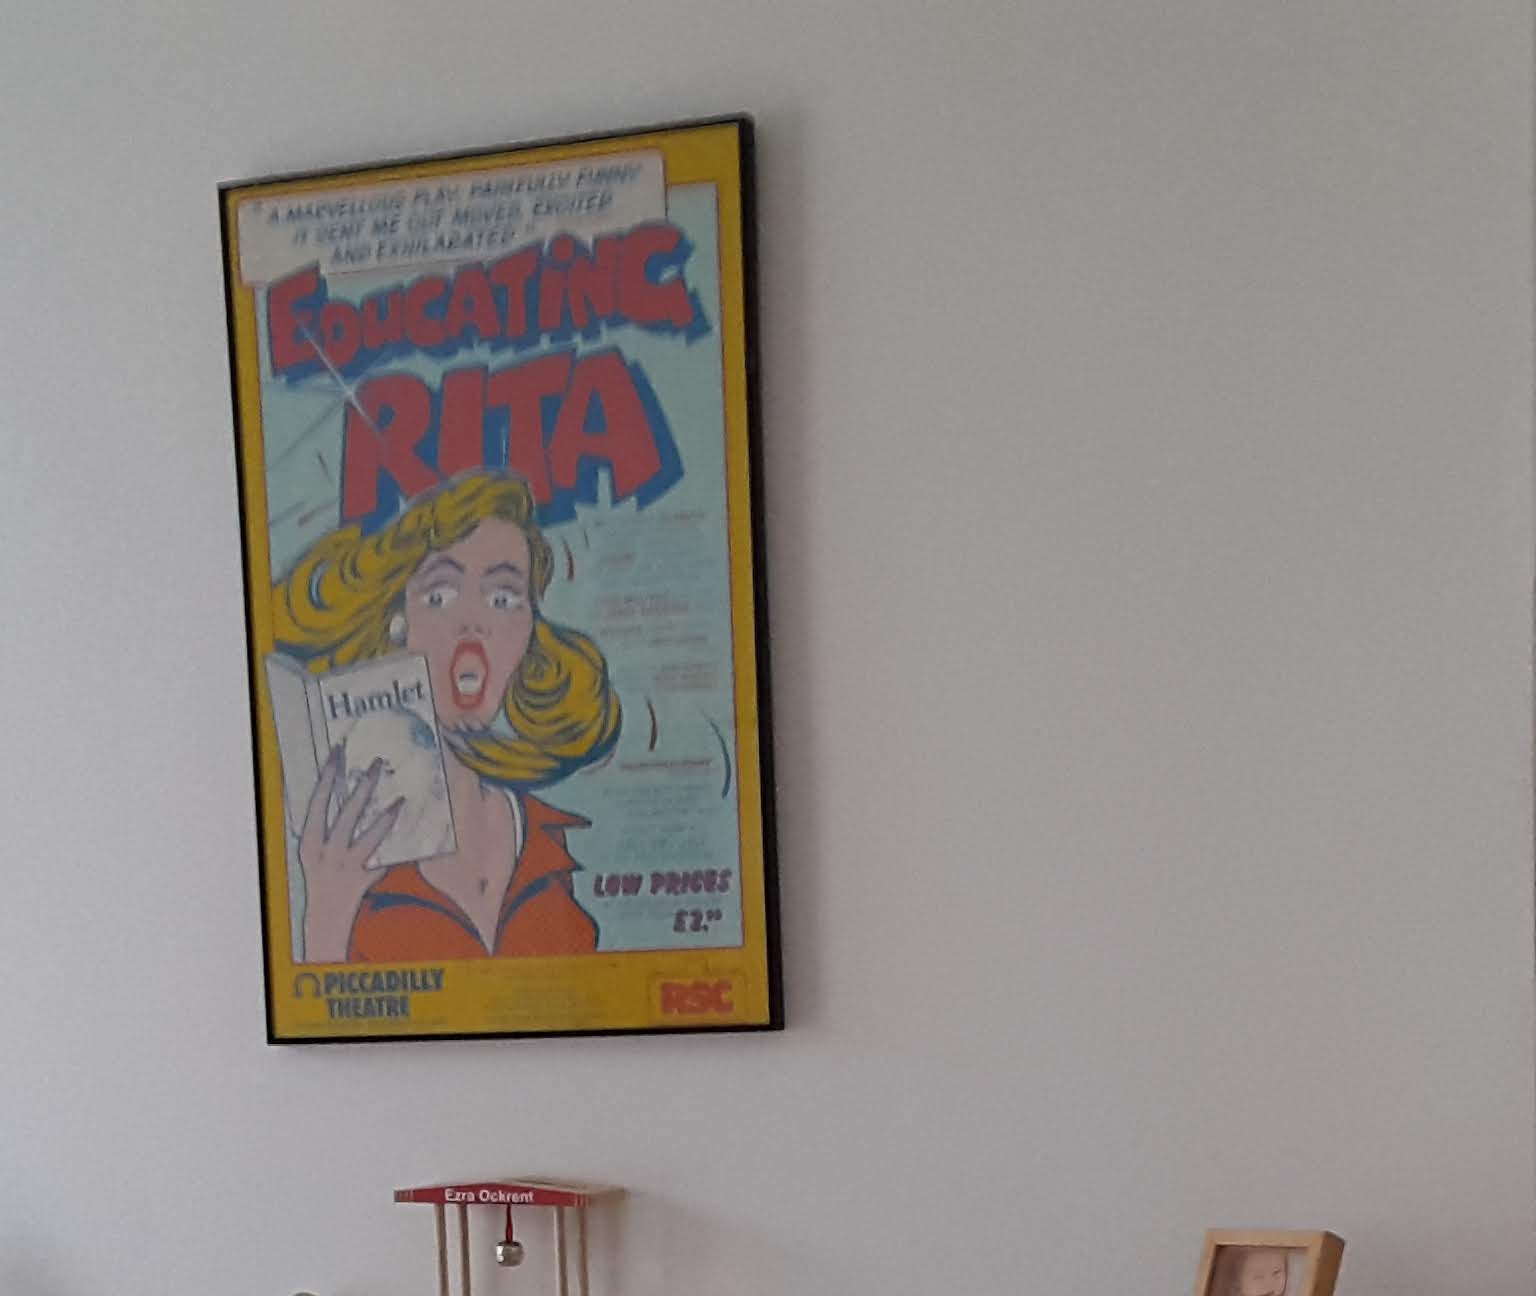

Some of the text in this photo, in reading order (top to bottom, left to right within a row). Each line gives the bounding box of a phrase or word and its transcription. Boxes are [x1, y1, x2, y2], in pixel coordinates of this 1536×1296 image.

[340, 345, 669, 525] RITA
[328, 679, 426, 720] Hamlet
[593, 867, 732, 898] LOW PRICES
[324, 968, 445, 996] PICCADILLY
[660, 979, 734, 1016] RSC
[326, 994, 410, 1019] THEATRE
[445, 1187, 535, 1205] Ezra Ockrent
